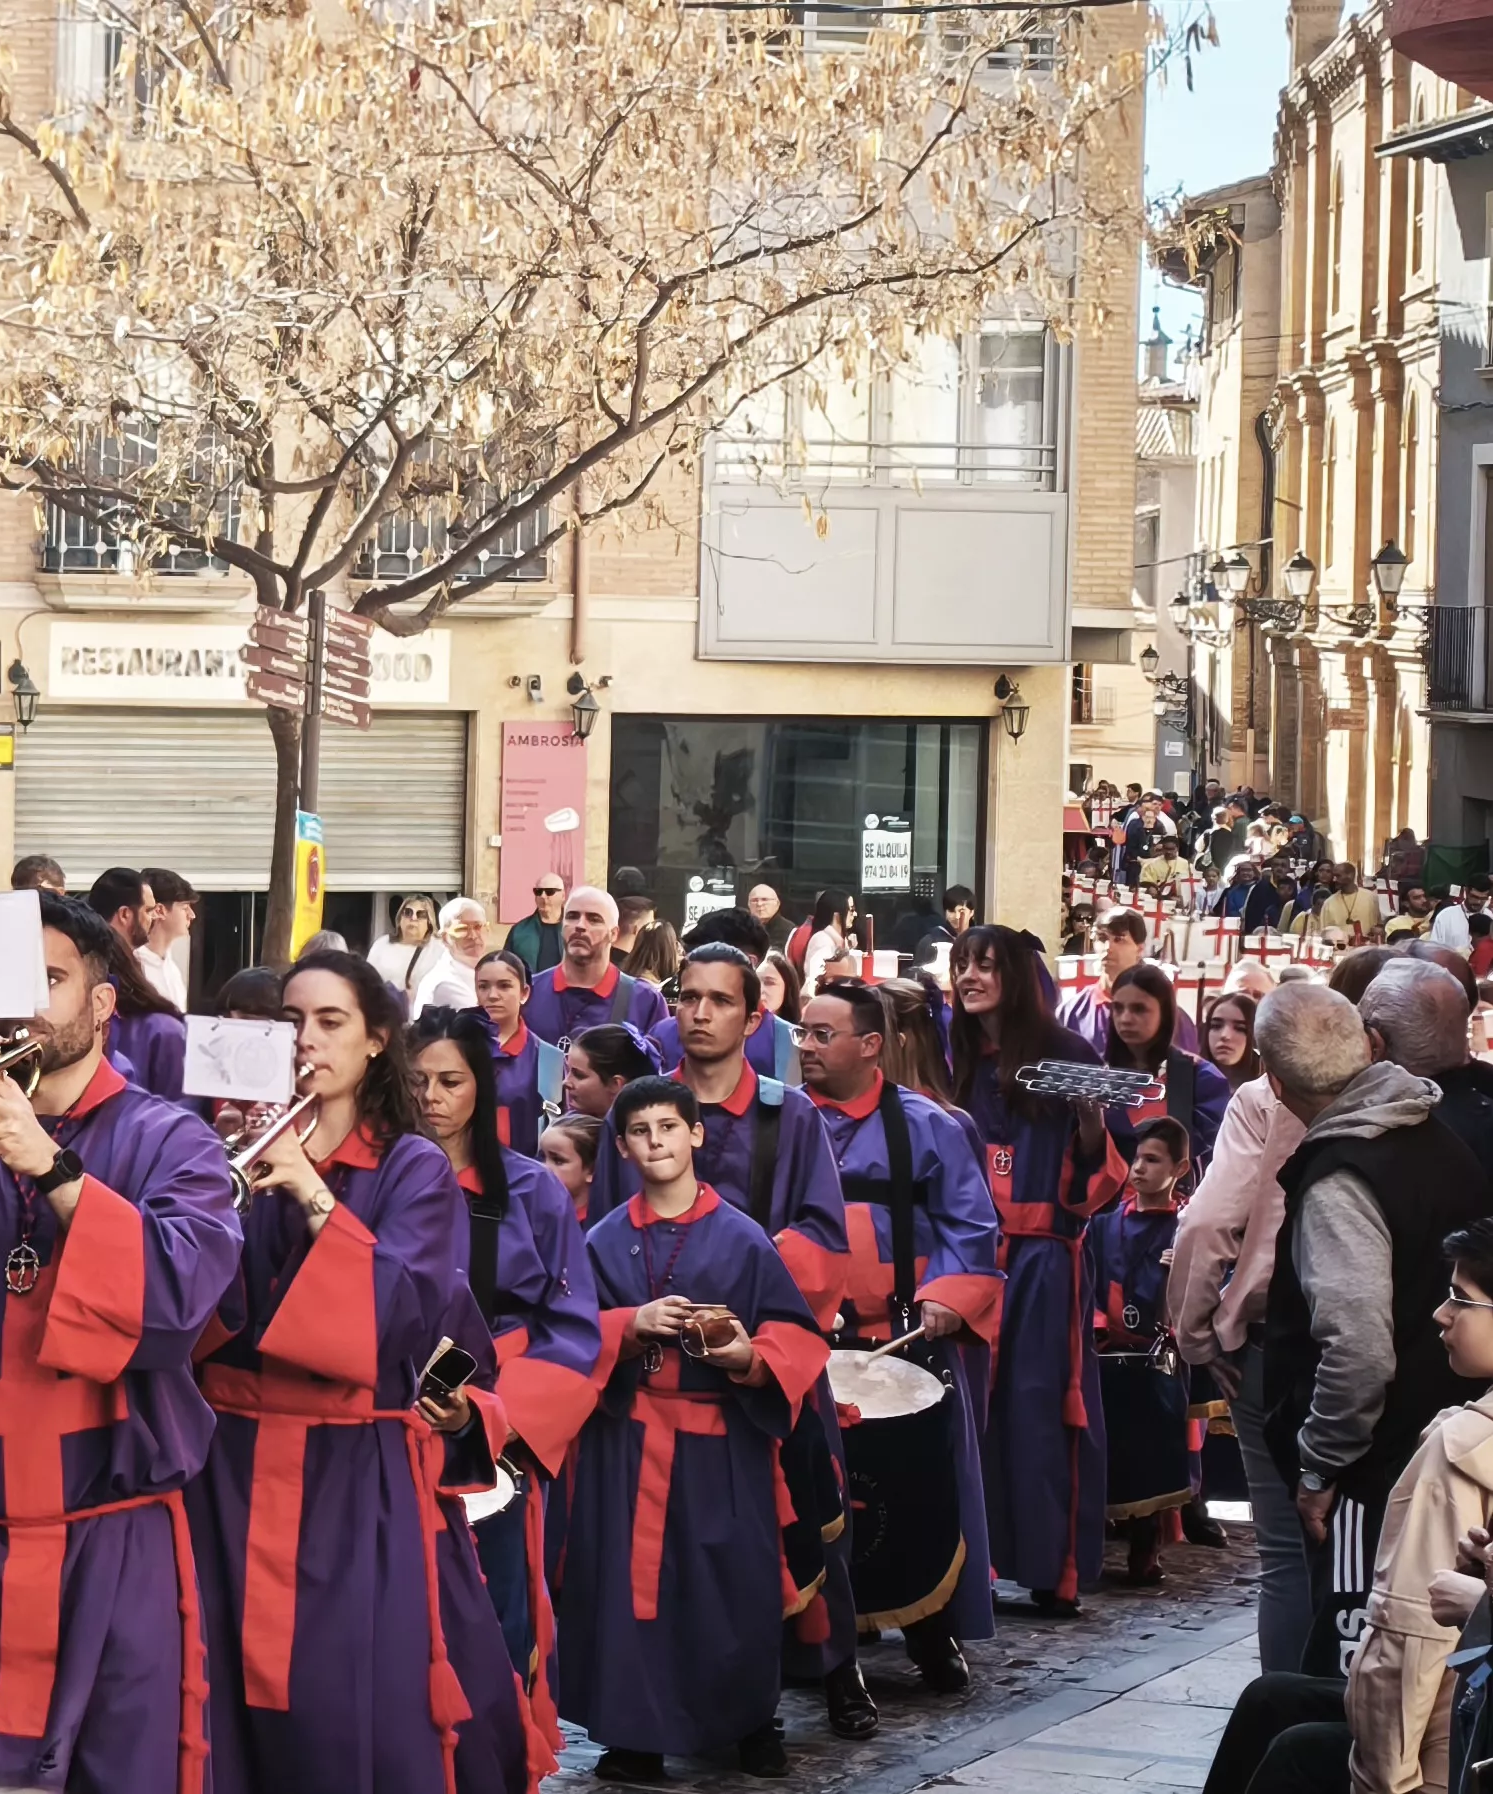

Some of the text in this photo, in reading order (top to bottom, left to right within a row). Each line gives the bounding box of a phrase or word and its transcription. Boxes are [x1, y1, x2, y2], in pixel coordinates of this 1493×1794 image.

[61, 646, 248, 677] RESTAURANT
[372, 652, 433, 682] OOD
[507, 734, 585, 747] AMBROSIA
[865, 842, 908, 858] SE ALQUILA
[689, 906, 698, 920] SE
